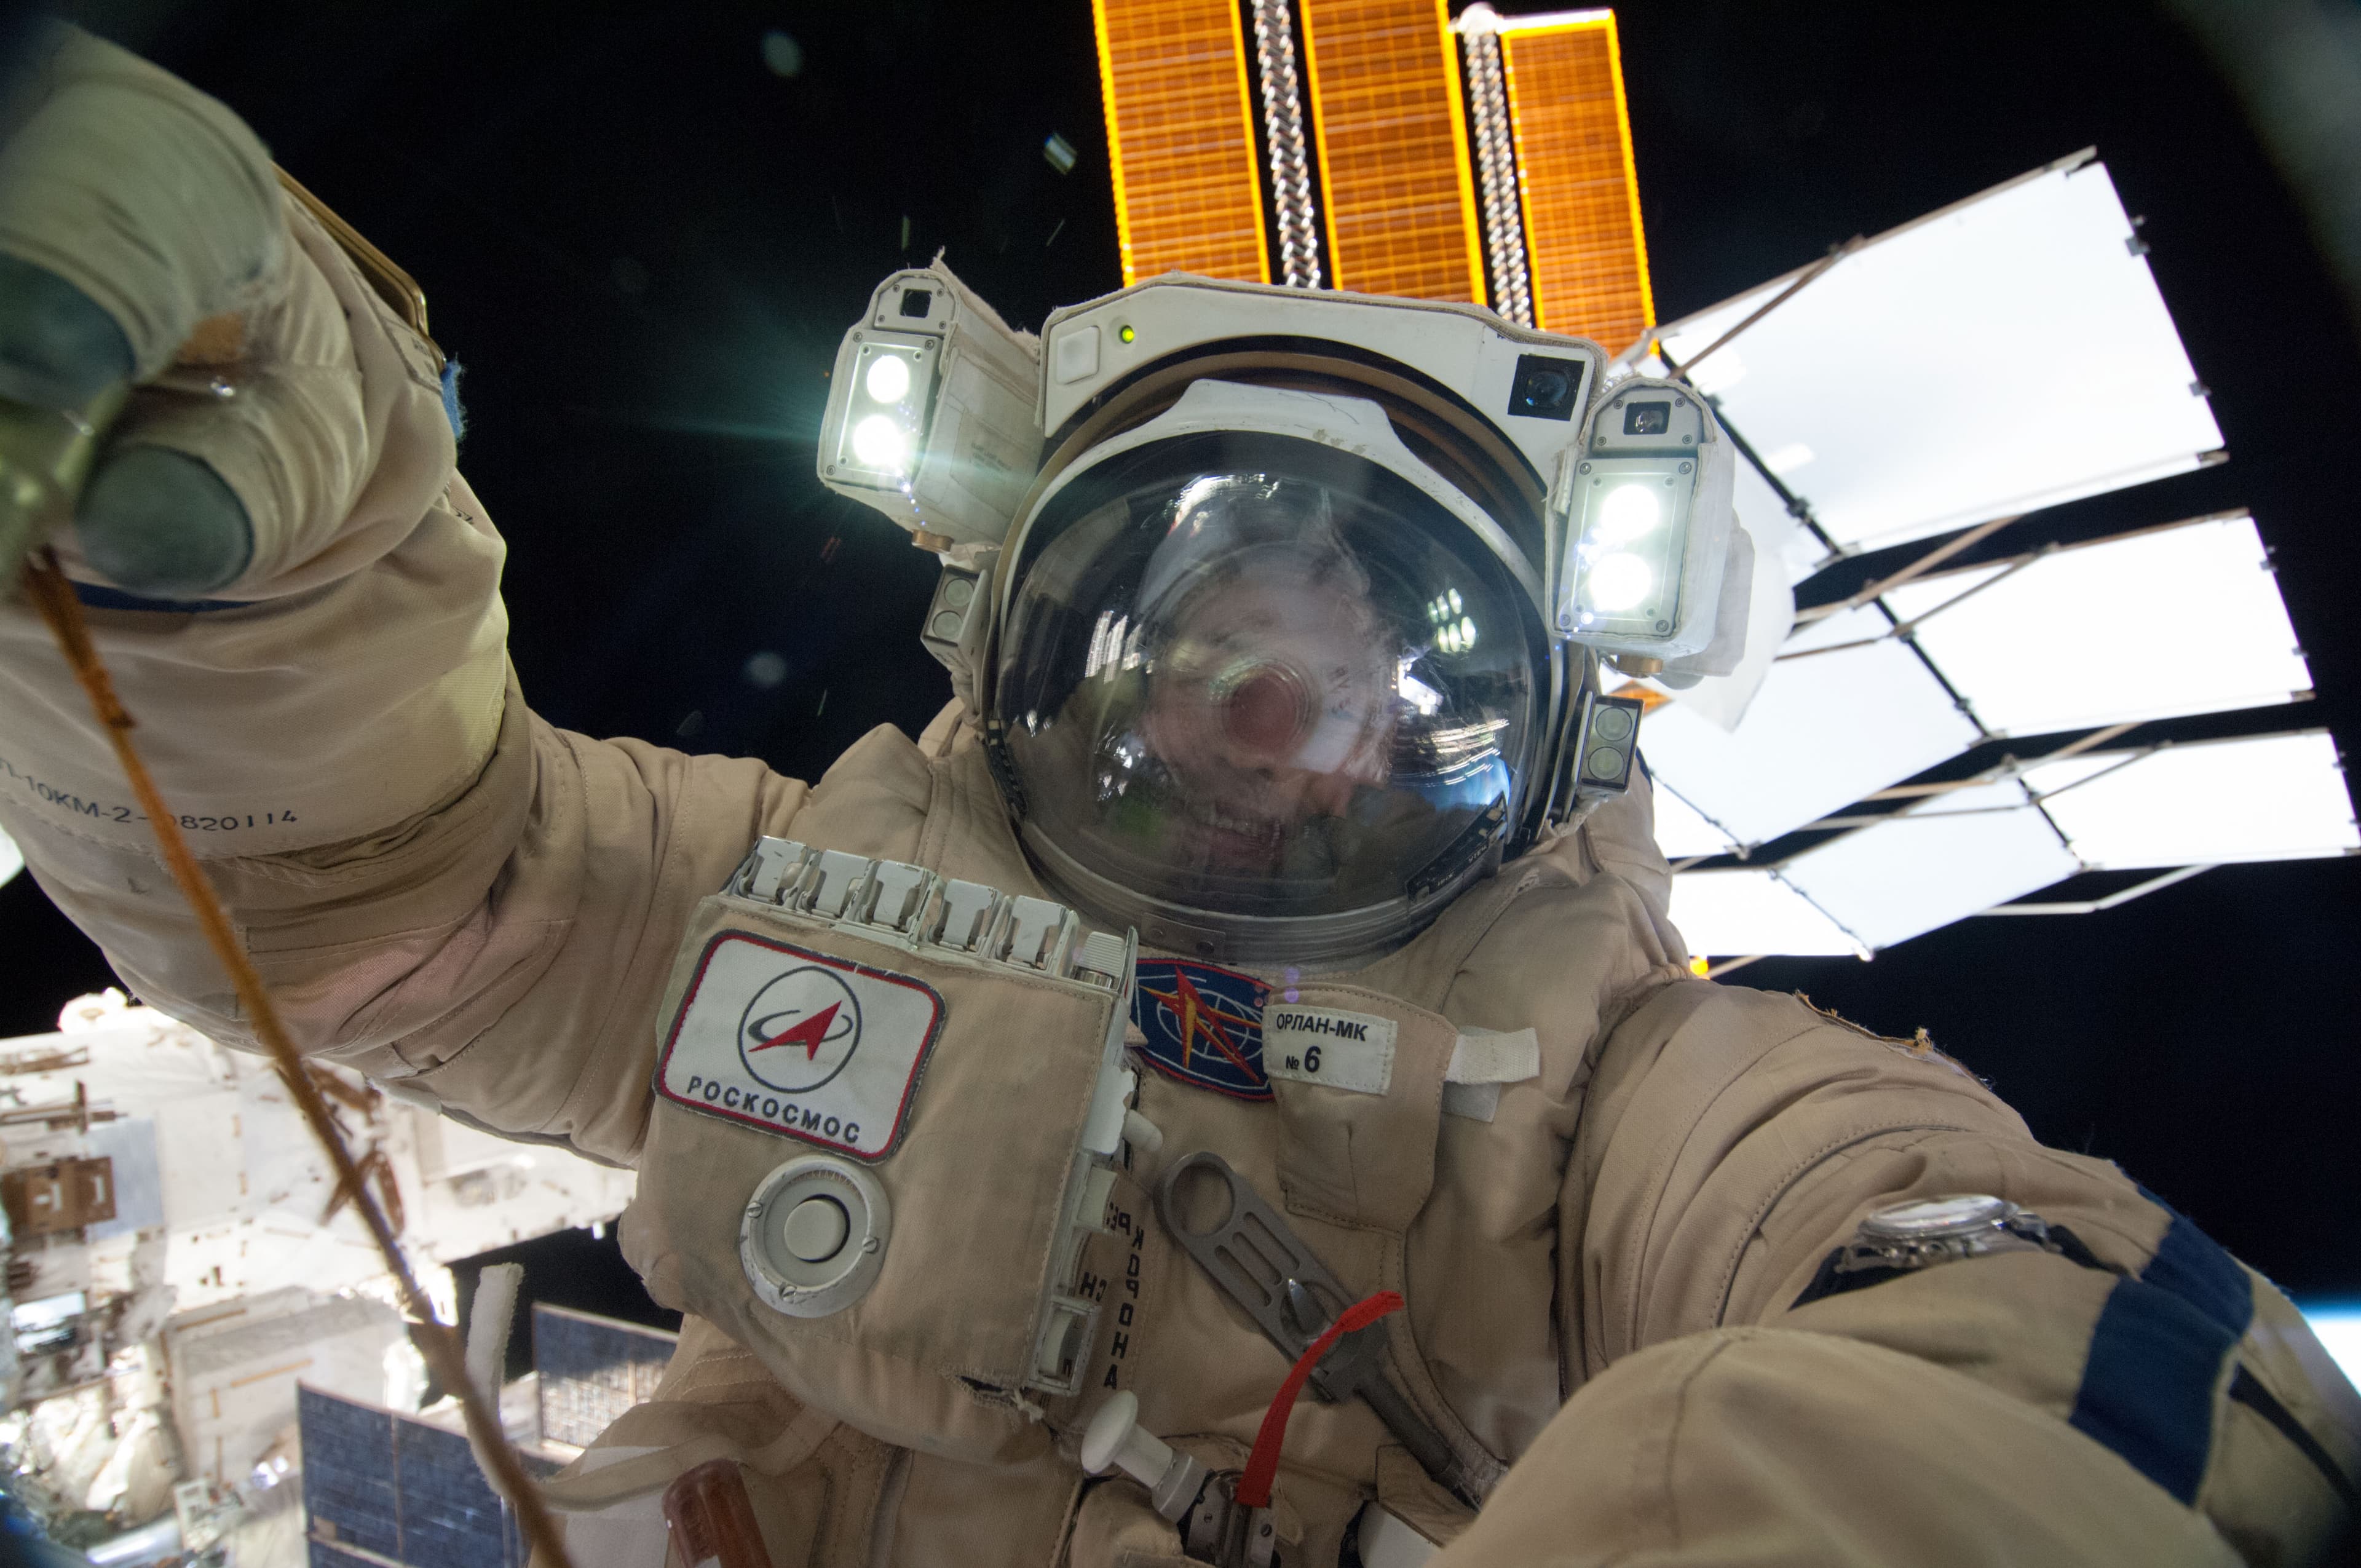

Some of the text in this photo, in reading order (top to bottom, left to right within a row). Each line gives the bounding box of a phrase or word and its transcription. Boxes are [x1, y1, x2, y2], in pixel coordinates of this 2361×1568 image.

[1276, 1013, 1368, 1041] ОРЛАН-МК
[1286, 1045, 1321, 1073] № 6
[687, 1075, 860, 1143] РОСКОСМОС
